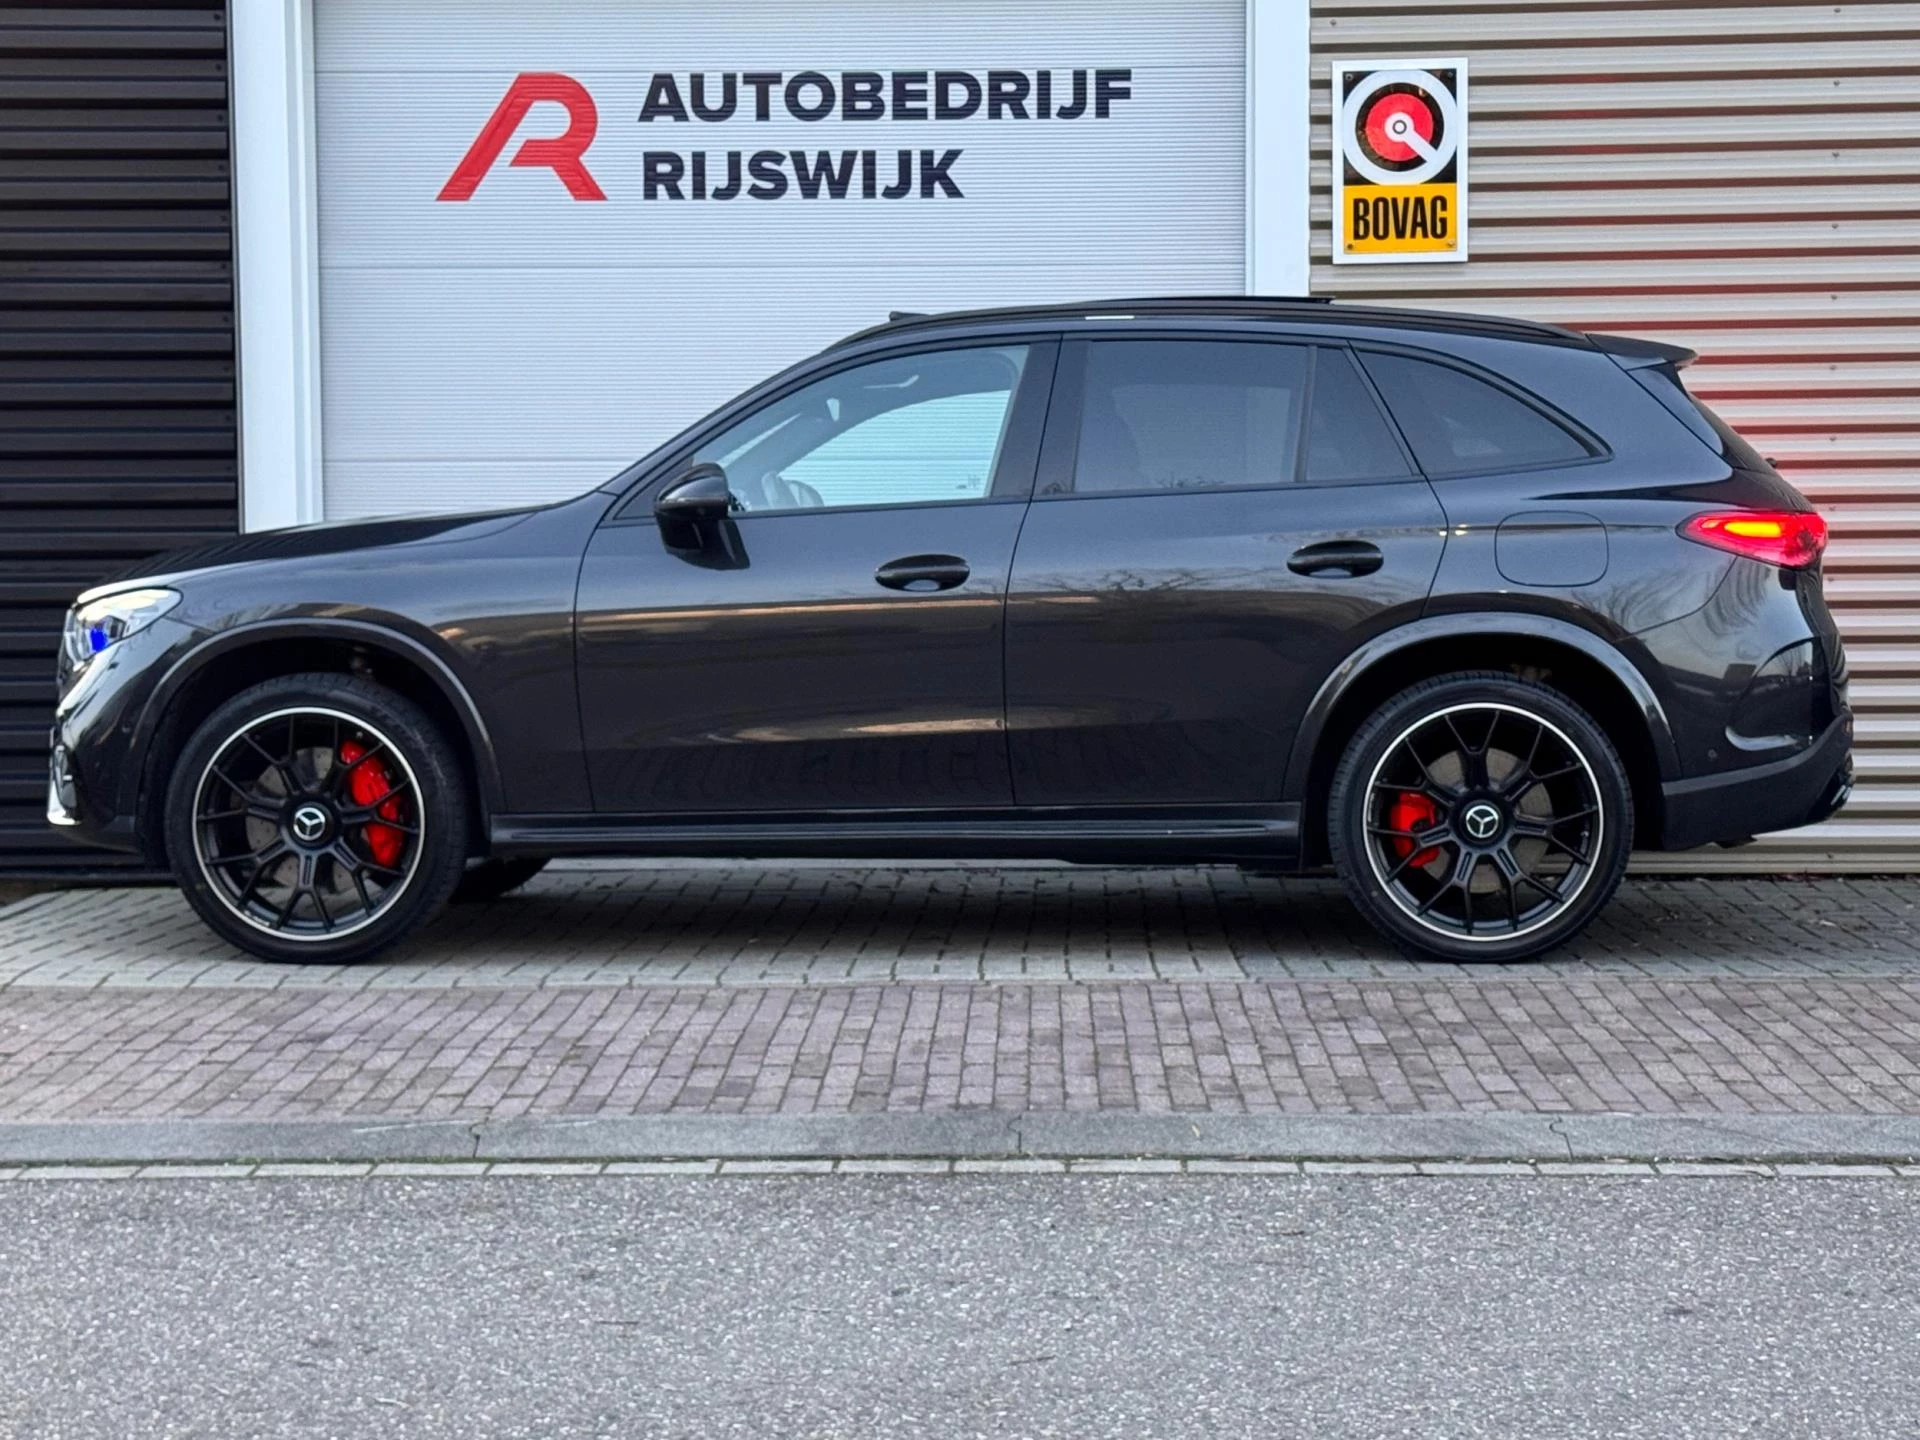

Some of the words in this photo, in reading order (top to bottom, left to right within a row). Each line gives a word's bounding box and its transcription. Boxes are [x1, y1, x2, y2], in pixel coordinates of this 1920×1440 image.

[638, 69, 1132, 122] AUTOBEDRIJF
[643, 149, 964, 201] RIJSWIJK
[1353, 195, 1448, 240] BOVAG
